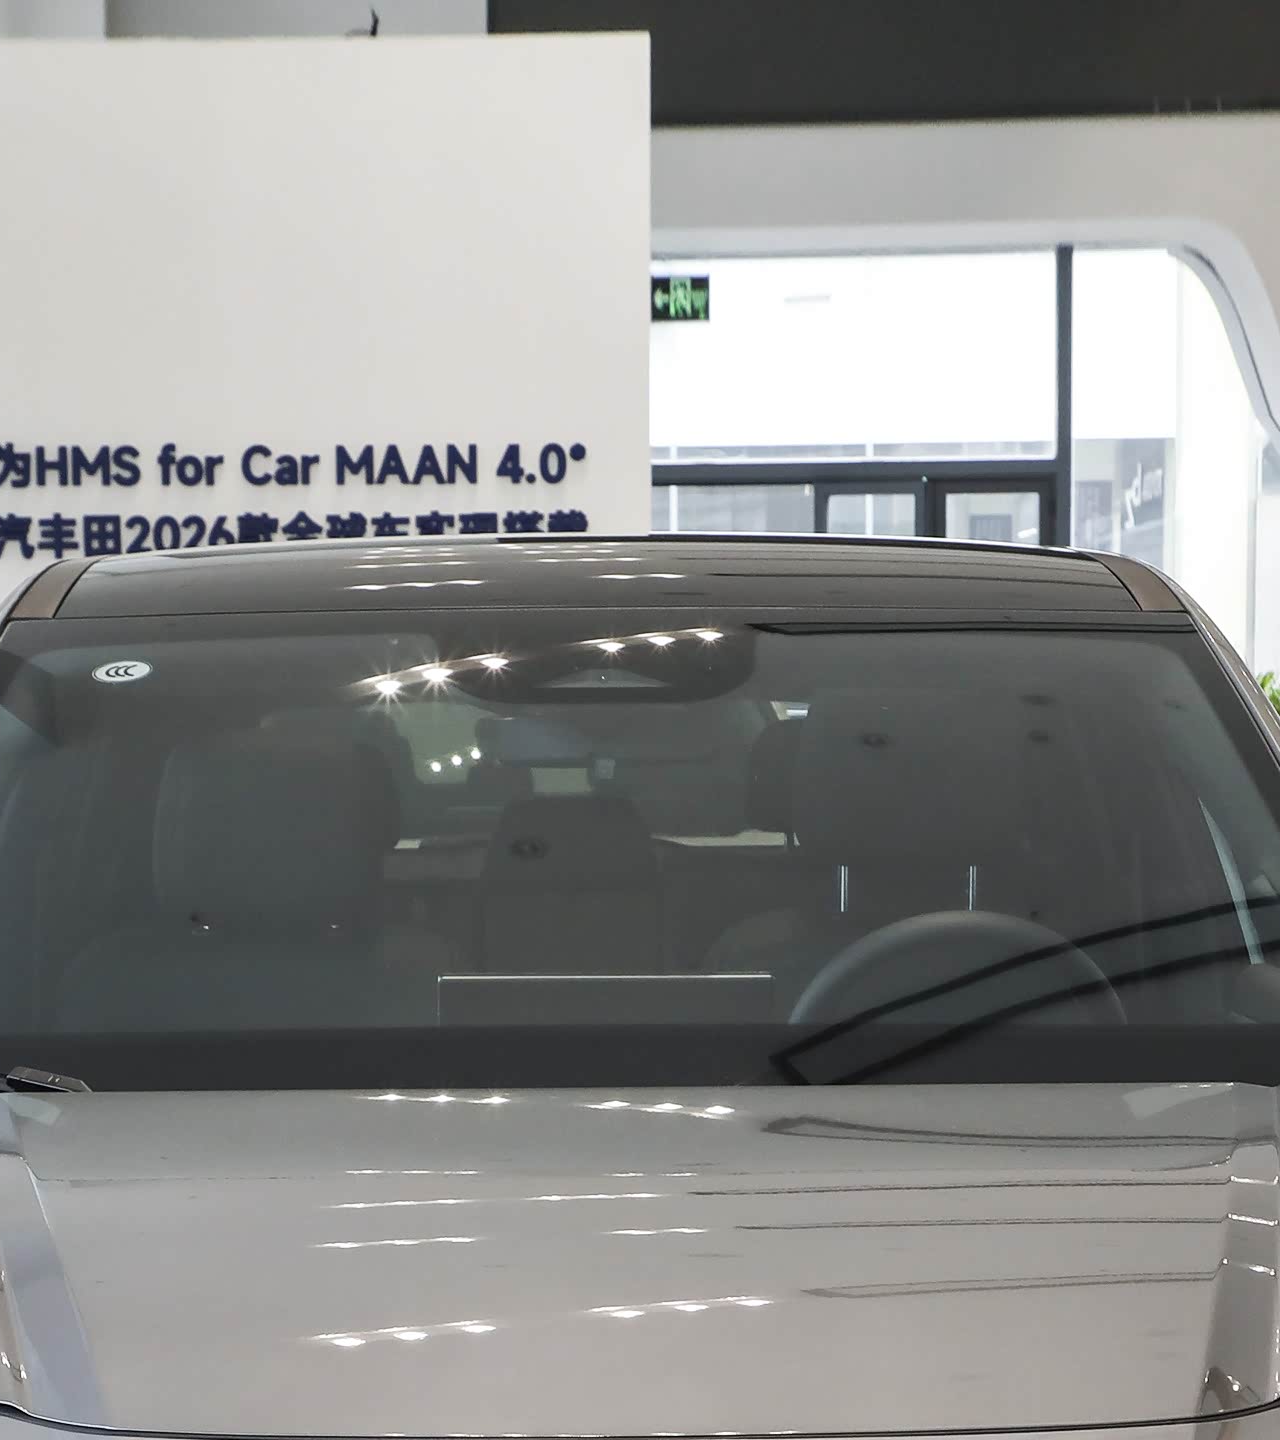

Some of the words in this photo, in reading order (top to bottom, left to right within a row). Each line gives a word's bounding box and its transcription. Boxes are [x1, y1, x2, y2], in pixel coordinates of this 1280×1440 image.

[157, 443, 225, 487] for
[241, 444, 320, 487] Car
[335, 443, 478, 486] MAAN
